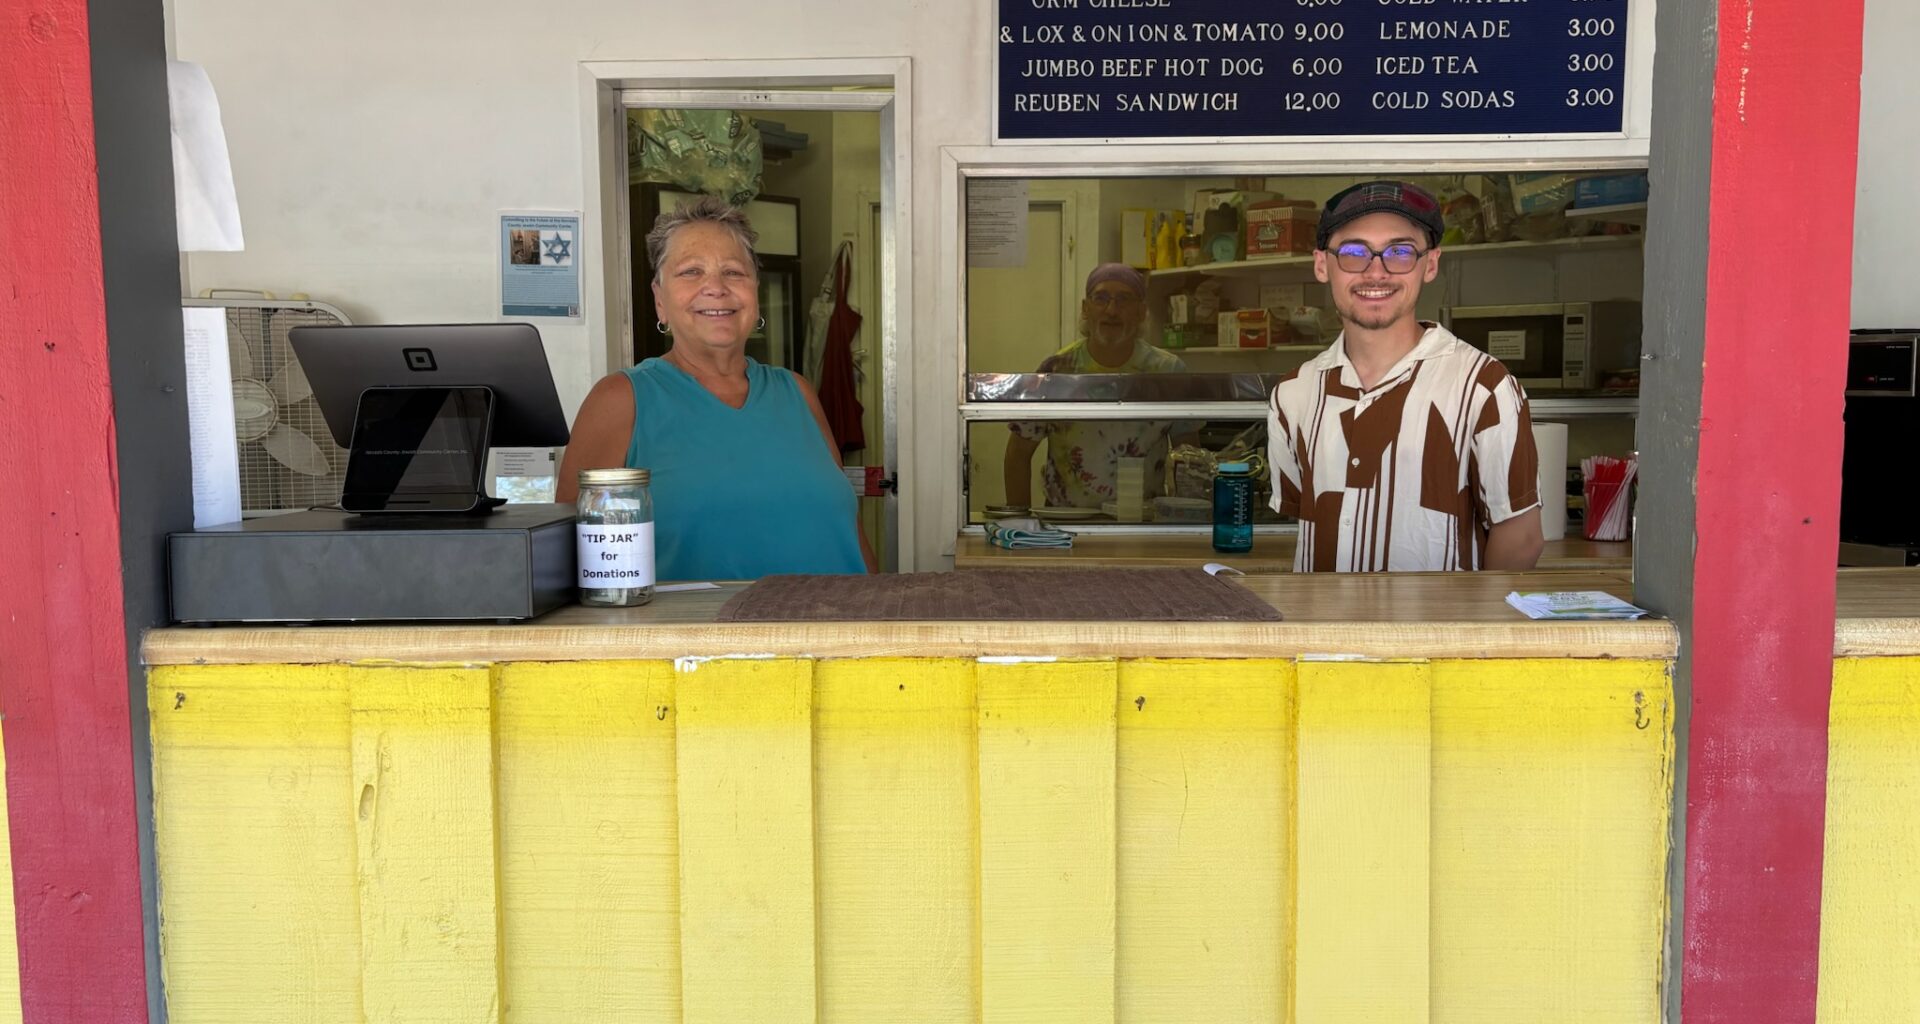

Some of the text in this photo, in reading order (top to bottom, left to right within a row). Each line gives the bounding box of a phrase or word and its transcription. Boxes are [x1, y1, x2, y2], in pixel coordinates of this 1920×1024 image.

[999, 25, 1015, 43] &
[1022, 24, 1065, 43] LOX
[1072, 24, 1087, 43] &
[1091, 24, 1168, 43] ONION
[1191, 22, 1284, 42] TOMATO
[1294, 22, 1344, 43] 9.00
[1379, 19, 1511, 40] LEMONADE
[1567, 17, 1615, 37] 3.00
[1021, 57, 1343, 78] JUMBO BEEF HOT DOG 6.00
[1376, 55, 1479, 75] ICED TEA
[1567, 53, 1614, 72] 3.00
[1014, 91, 1341, 112] REUBEN SANDWICH 12.00
[1372, 90, 1515, 110] COLD SODAS
[1565, 87, 1614, 107] 3.00
[601, 551, 618, 561] for
[583, 568, 640, 579] Donations
